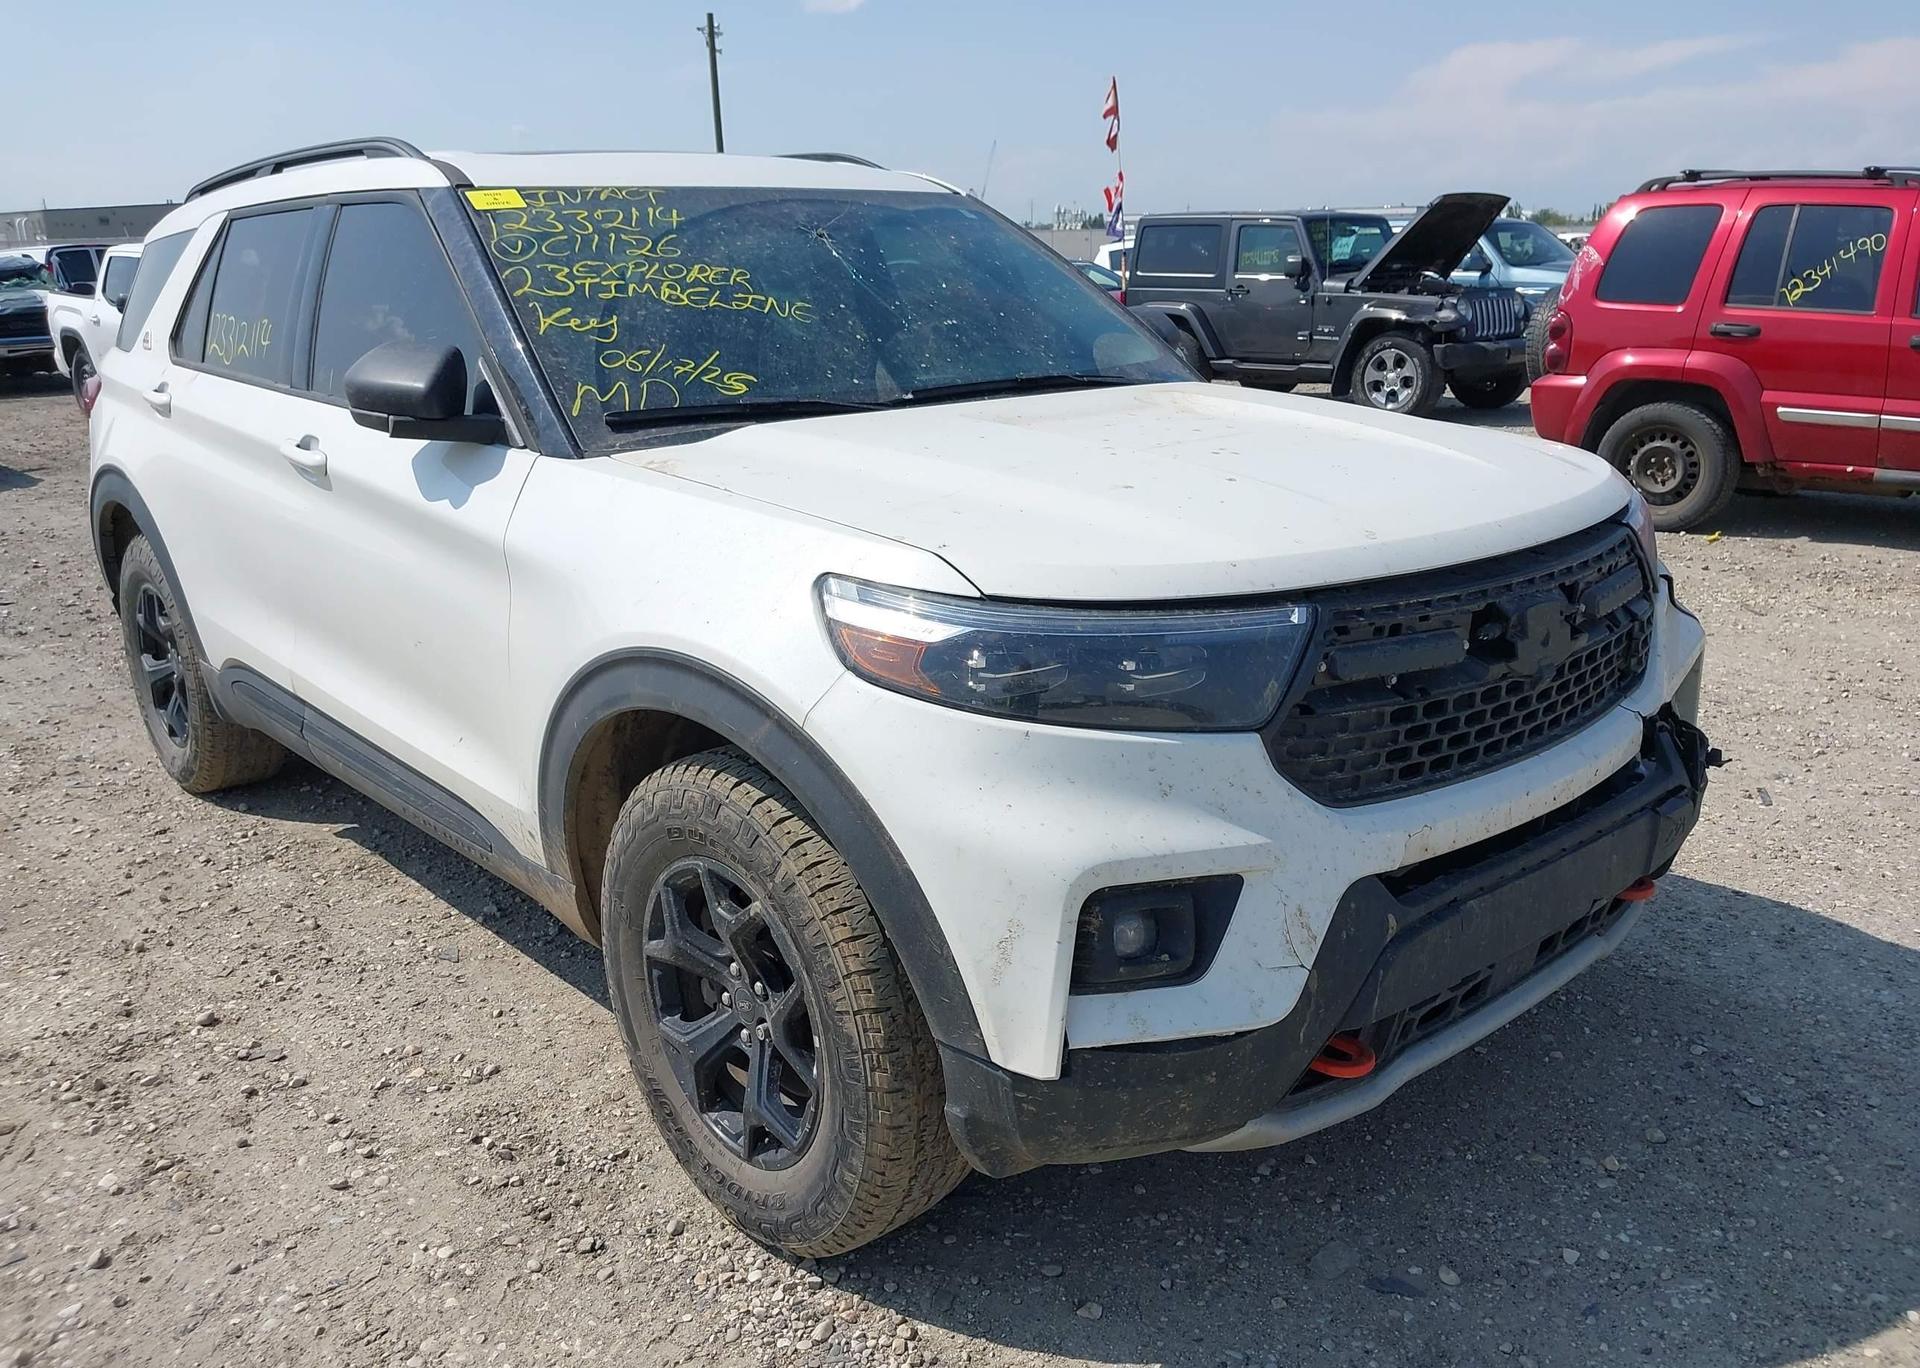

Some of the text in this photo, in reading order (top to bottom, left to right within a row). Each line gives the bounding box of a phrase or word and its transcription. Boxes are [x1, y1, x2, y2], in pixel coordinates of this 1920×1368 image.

[520, 187, 666, 207] INTACT
[573, 259, 753, 293] EXPLORER
[1780, 233, 1887, 307] 12341490
[528, 301, 618, 343] Key
[572, 378, 680, 417] MD
